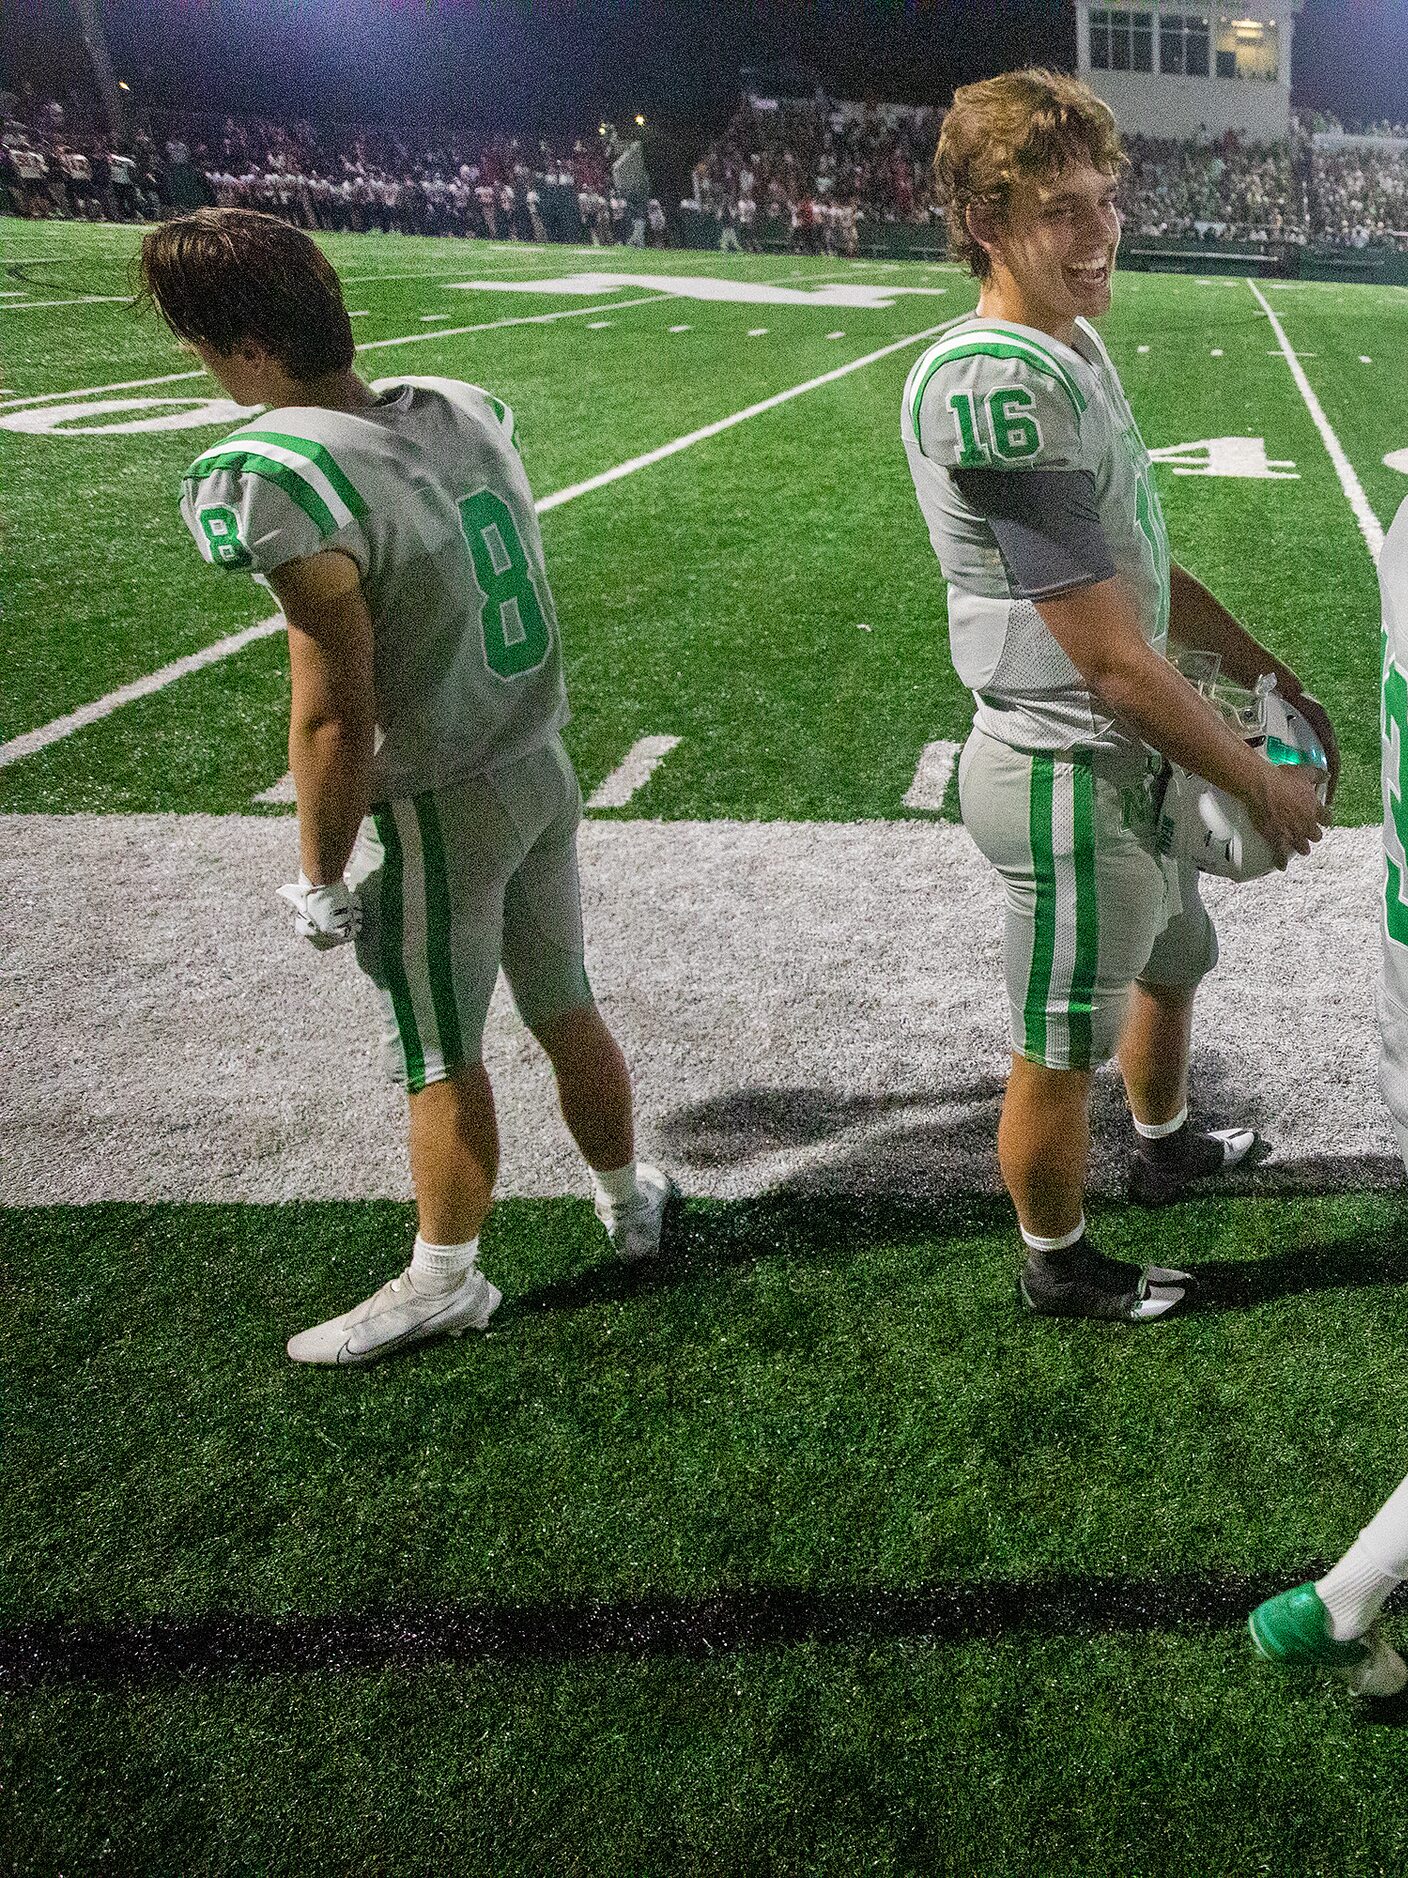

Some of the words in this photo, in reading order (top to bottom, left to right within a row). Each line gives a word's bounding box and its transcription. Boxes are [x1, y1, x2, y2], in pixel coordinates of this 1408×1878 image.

[945, 384, 1045, 468] 16
[196, 502, 255, 572] 8
[457, 487, 553, 682] 8
